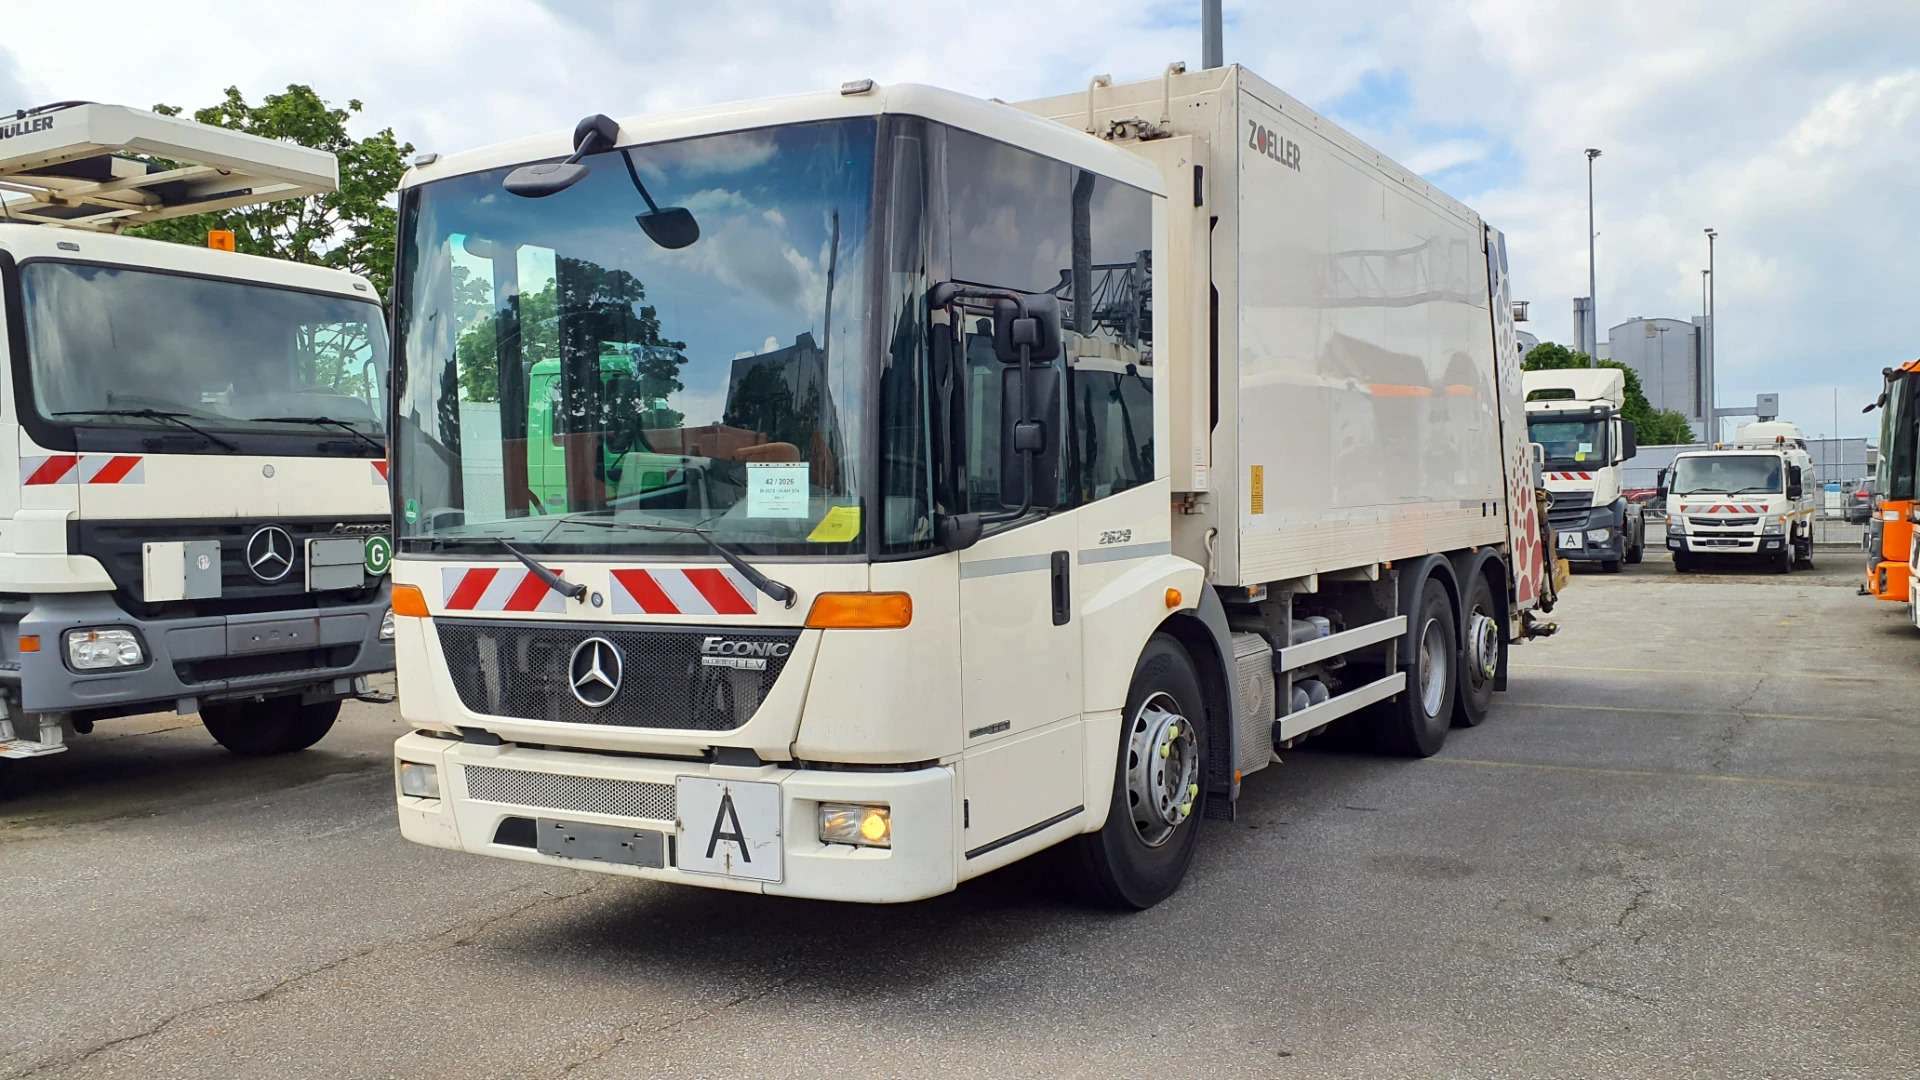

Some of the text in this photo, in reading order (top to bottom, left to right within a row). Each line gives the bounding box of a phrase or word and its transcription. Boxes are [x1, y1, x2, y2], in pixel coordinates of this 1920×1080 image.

[0, 116, 53, 139] ÜLLER
[1248, 119, 1301, 173] ZOELLER
[1565, 533, 1576, 546] A
[371, 544, 384, 566] G
[705, 791, 751, 863] A
